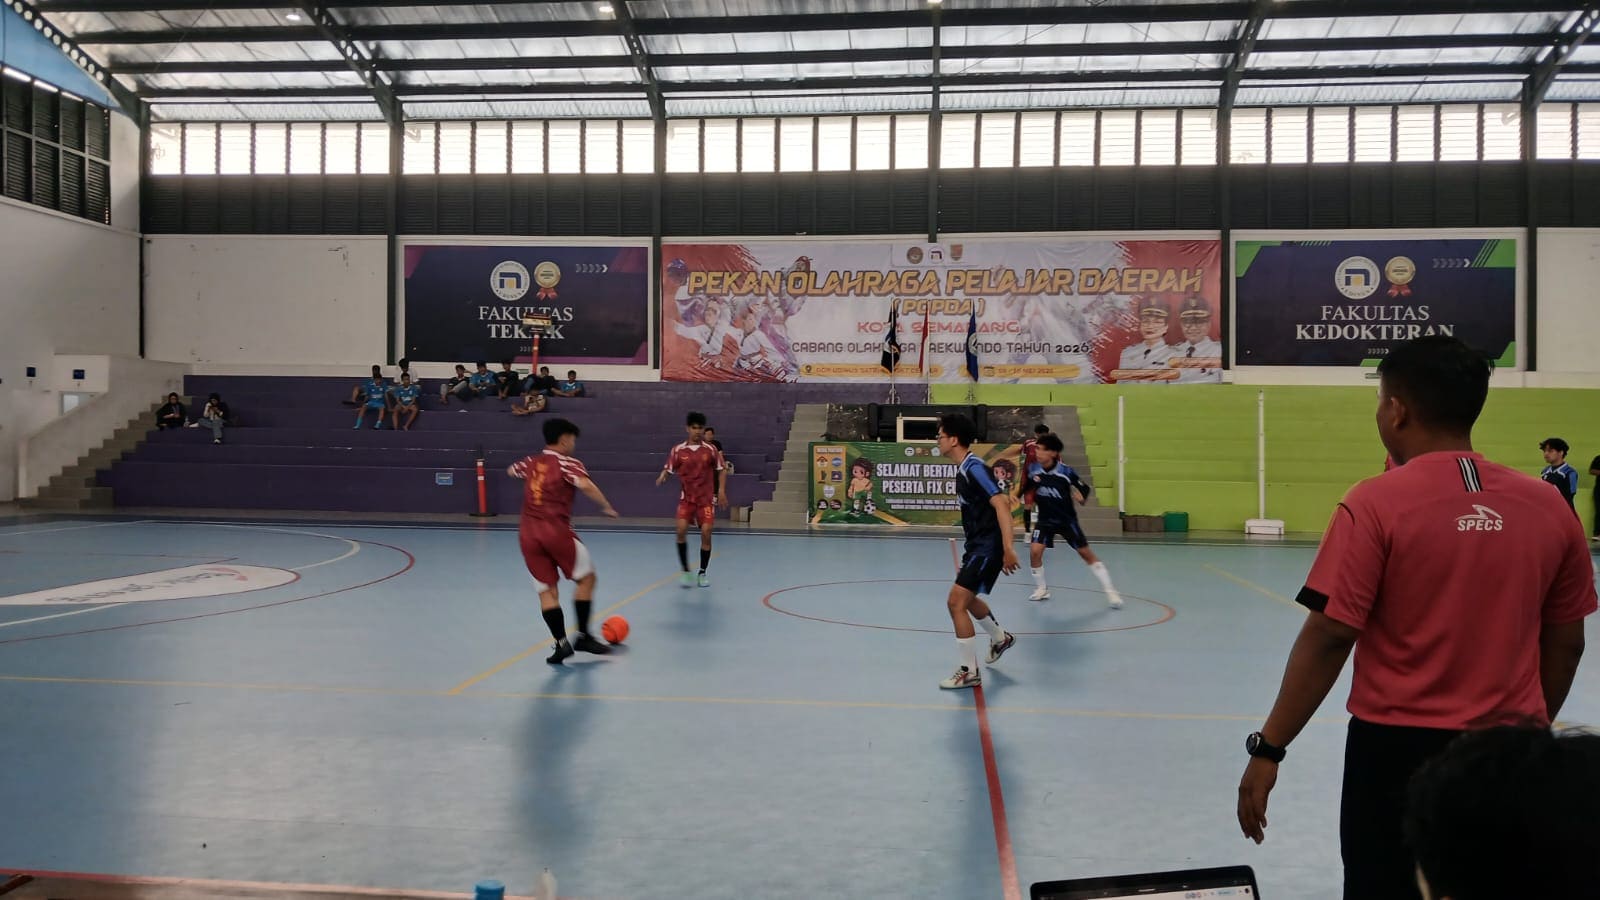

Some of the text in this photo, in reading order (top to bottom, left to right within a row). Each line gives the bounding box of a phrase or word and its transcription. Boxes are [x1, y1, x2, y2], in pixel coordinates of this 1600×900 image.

[688, 267, 1204, 297] PEKAN OLAHRAGA PELAJAR DAERAH
[1321, 305, 1430, 321] FAKULTAS
[487, 324, 565, 339] TEKK
[911, 321, 1020, 333] SEMAANG
[1296, 324, 1455, 340] KEDOKTERAN
[792, 341, 1090, 353] CABANG OLAHGA AEKWNDO TAHUN 2026
[876, 463, 920, 477] SELAMAT
[882, 480, 957, 495] PESERTA FIX CU
[1457, 519, 1503, 531] SPECS
